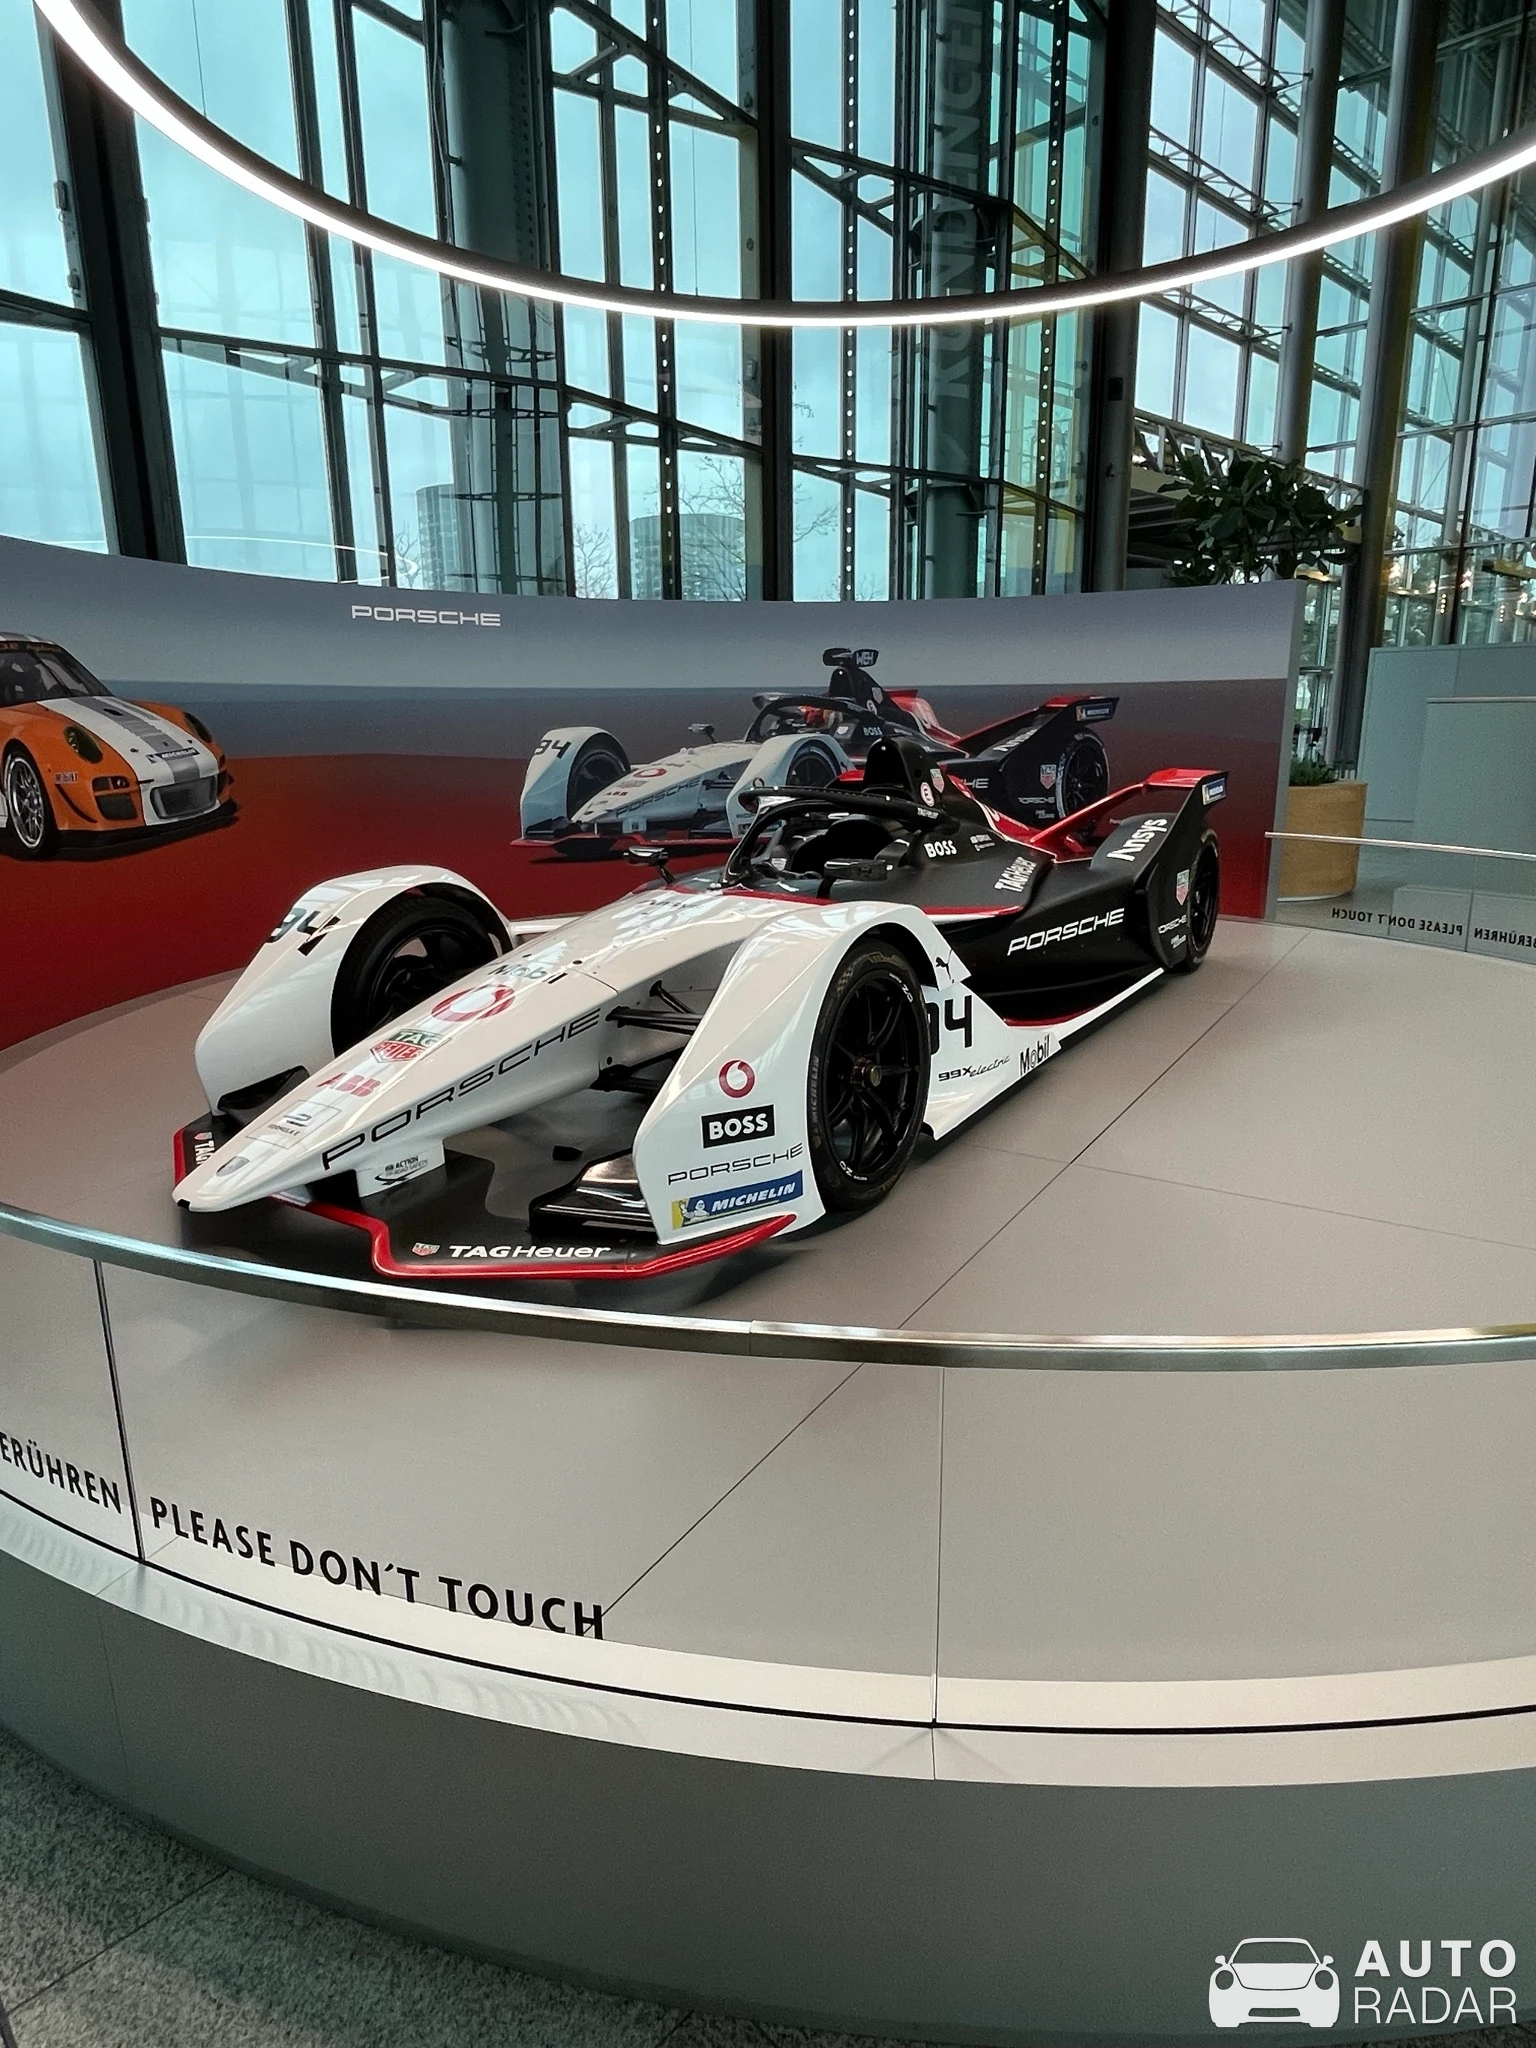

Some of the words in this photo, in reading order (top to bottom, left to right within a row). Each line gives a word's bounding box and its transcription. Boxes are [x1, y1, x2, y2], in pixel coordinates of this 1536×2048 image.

[352, 605, 500, 627] PORSCHE
[863, 727, 883, 736] BOSS
[616, 777, 701, 817] PORSCHE
[924, 840, 957, 858] BOSS
[1106, 818, 1168, 862] Ansys
[1007, 908, 1125, 956] PORSCHE
[487, 965, 568, 984] Mobil
[394, 1032, 438, 1048] TAG
[1020, 1034, 1050, 1076] Mobil
[316, 1072, 382, 1098] ABB
[322, 1008, 600, 1171] PORSCHE
[709, 1113, 768, 1140] BOSS
[395, 1155, 419, 1169] ACTION
[668, 1143, 803, 1186] PORSCHE
[711, 1182, 796, 1212] MICHELIN
[150, 1496, 276, 1567] PLEASE
[438, 1575, 603, 1640] TOUCH
